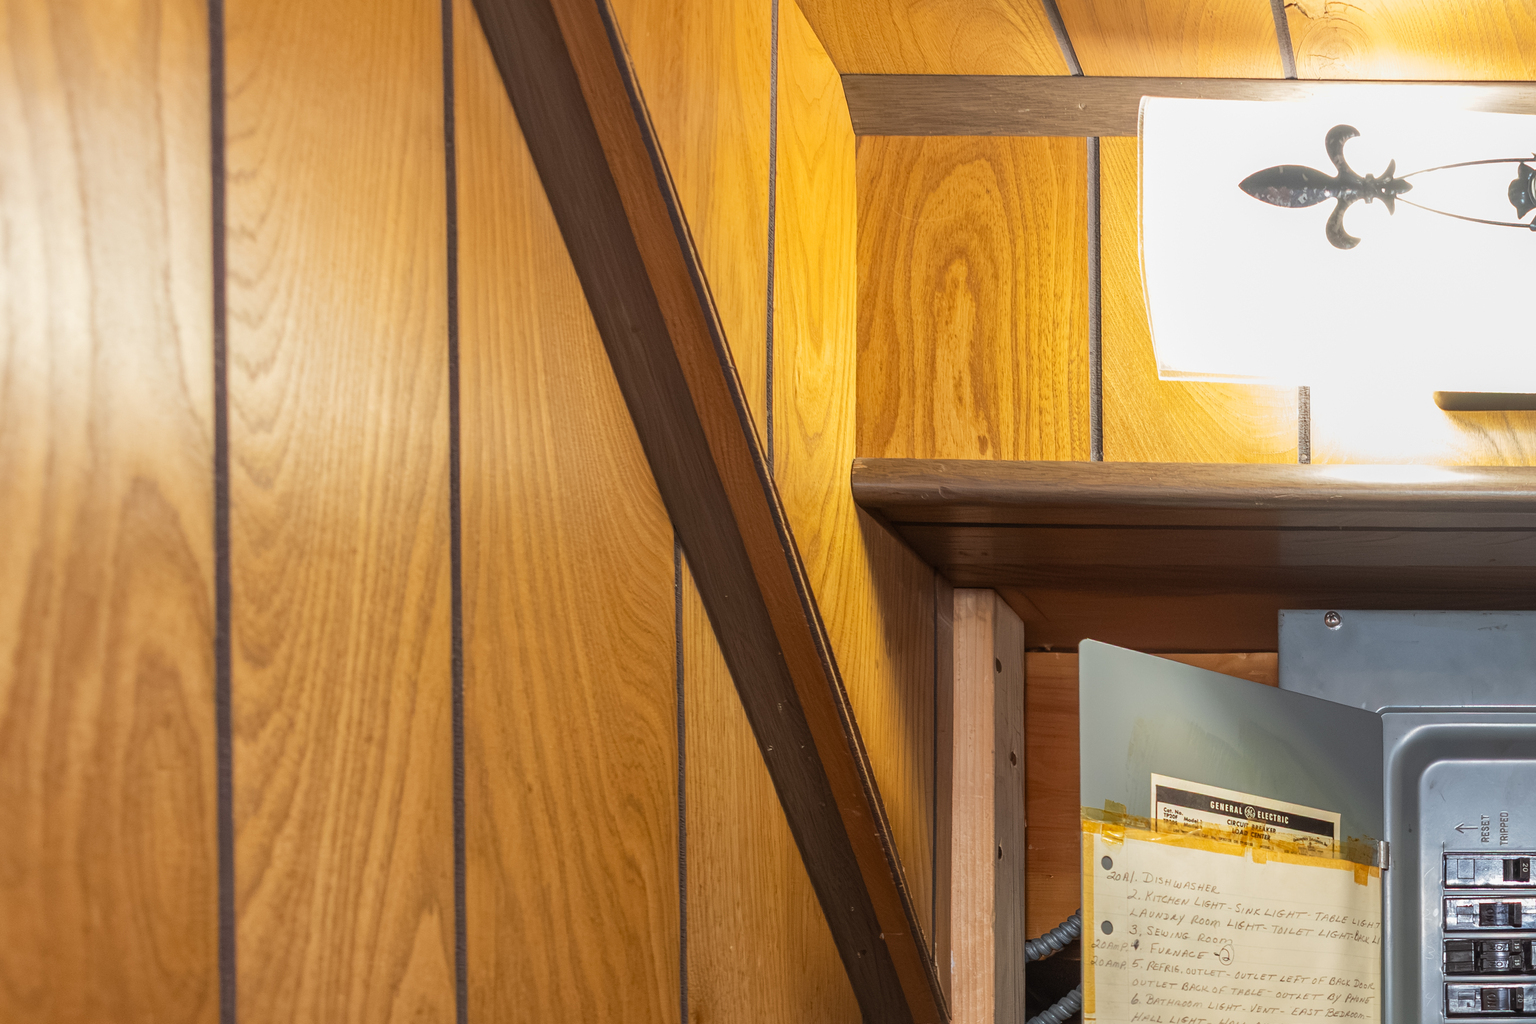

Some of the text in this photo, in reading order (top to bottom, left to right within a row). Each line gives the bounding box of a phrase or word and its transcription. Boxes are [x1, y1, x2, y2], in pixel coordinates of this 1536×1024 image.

[1210, 801, 1243, 815] GENERAL
[1257, 810, 1289, 824] ELECTRIC
[1226, 819, 1249, 829] CIRCUIT
[1231, 827, 1249, 837] LOAD
[1250, 831, 1271, 841] CENTER
[1481, 814, 1490, 843] RESET
[1500, 810, 1509, 846] TRIPPED
[1522, 863, 1529, 873] 20
[1142, 872, 1220, 895] DISHWASHER
[1145, 891, 1190, 906] KITCHEN
[1194, 897, 1227, 910] LIGHT
[1235, 903, 1260, 916] SINK
[1315, 911, 1348, 924] TABLE
[1129, 908, 1185, 926] LAUNDRY
[1190, 915, 1221, 928] ROOM
[1271, 924, 1314, 936] TOILET
[1146, 925, 1191, 940] SEWING
[1197, 933, 1233, 945] ROOM
[1150, 942, 1209, 960] FURNACE
[1132, 979, 1178, 989] OUTLET
[1182, 982, 1209, 993] BACK
[1212, 985, 1228, 994] OF
[1231, 987, 1266, 997] TABLE
[1276, 991, 1324, 1002] OUTLET
[1327, 992, 1342, 1004] BY
[1235, 971, 1277, 981] OUTLET
[1280, 975, 1311, 984] LEFT
[1312, 976, 1327, 985] OF
[1329, 977, 1351, 987] BACK
[1353, 979, 1375, 990] DOOR
[1146, 993, 1203, 1008] BATHROOM
[1291, 1007, 1324, 1016] EAST
[1131, 1012, 1163, 1024] HALL
